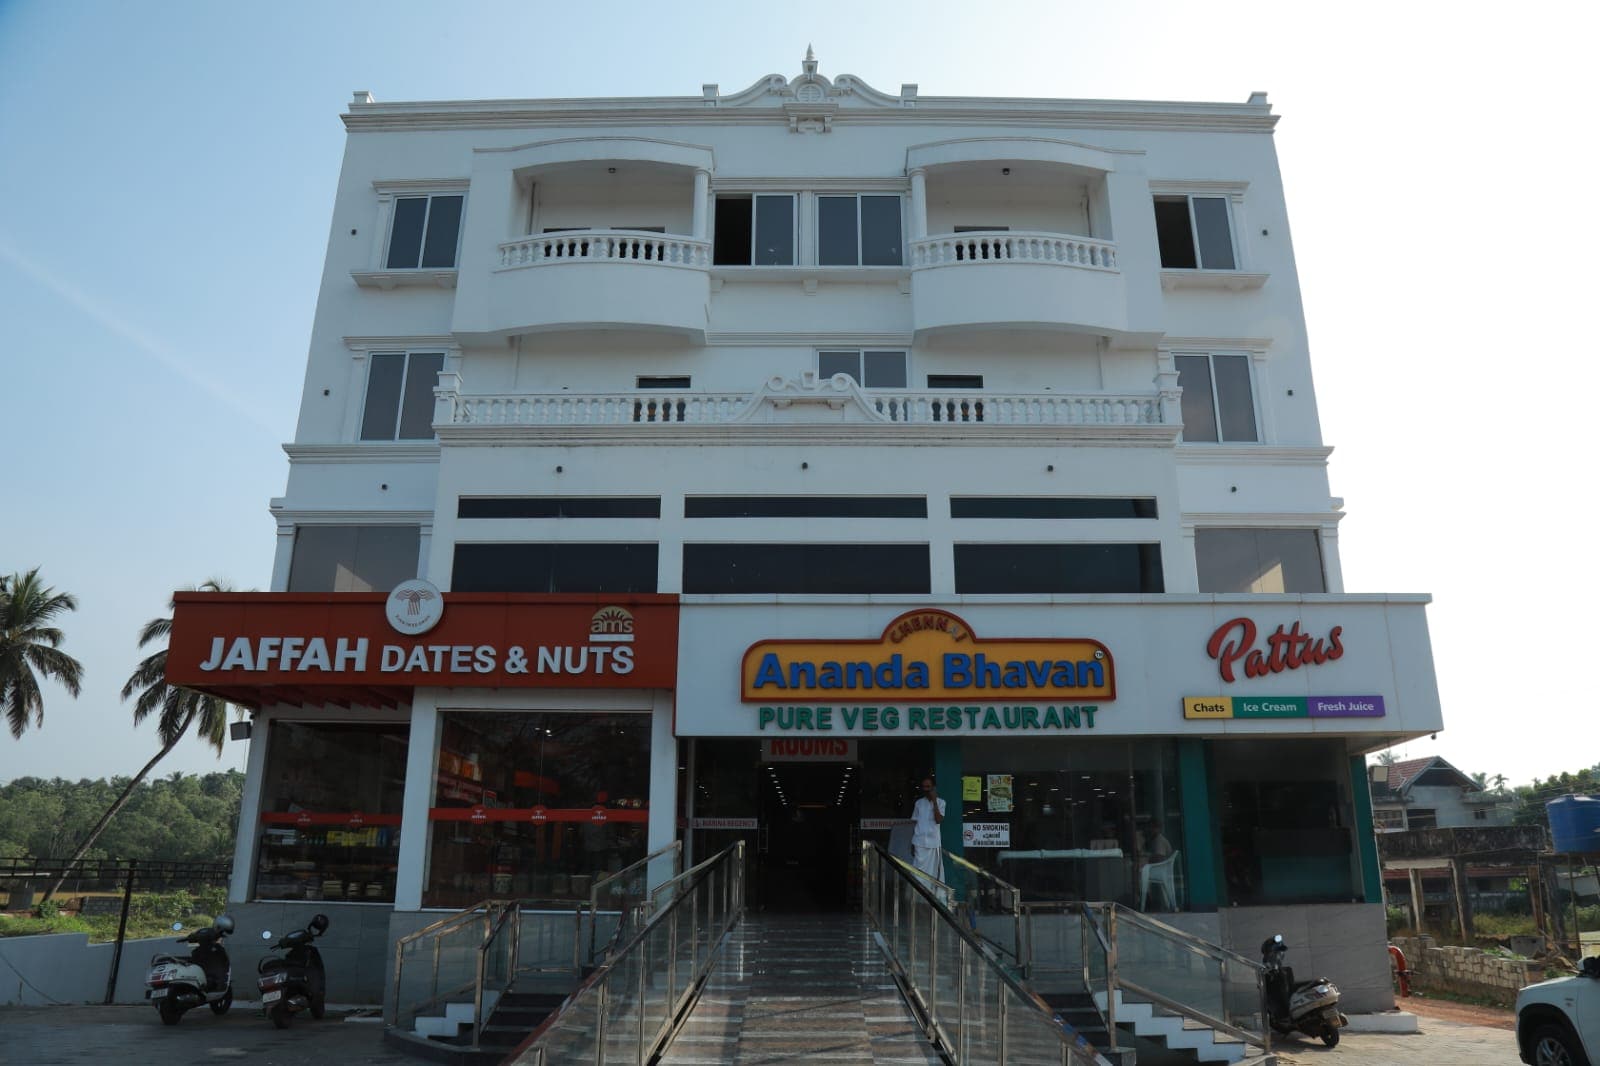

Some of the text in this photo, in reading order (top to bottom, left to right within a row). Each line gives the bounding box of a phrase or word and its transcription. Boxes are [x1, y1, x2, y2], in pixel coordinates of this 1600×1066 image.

[591, 618, 634, 633] ams
[889, 615, 967, 643] CHENNAI
[200, 637, 635, 675] JAFFAH DATES & NUTS
[1206, 617, 1345, 684] Pattus
[752, 652, 1105, 689] Ananda Bhavan
[1193, 703, 1226, 713] Chats
[1243, 702, 1297, 712] Ice Cream
[1317, 702, 1375, 712] Fresh Juice
[759, 705, 1099, 731] PURE VEG RESTAURANT
[770, 737, 849, 756] ROOMS
[982, 824, 1009, 832] SMOKING
